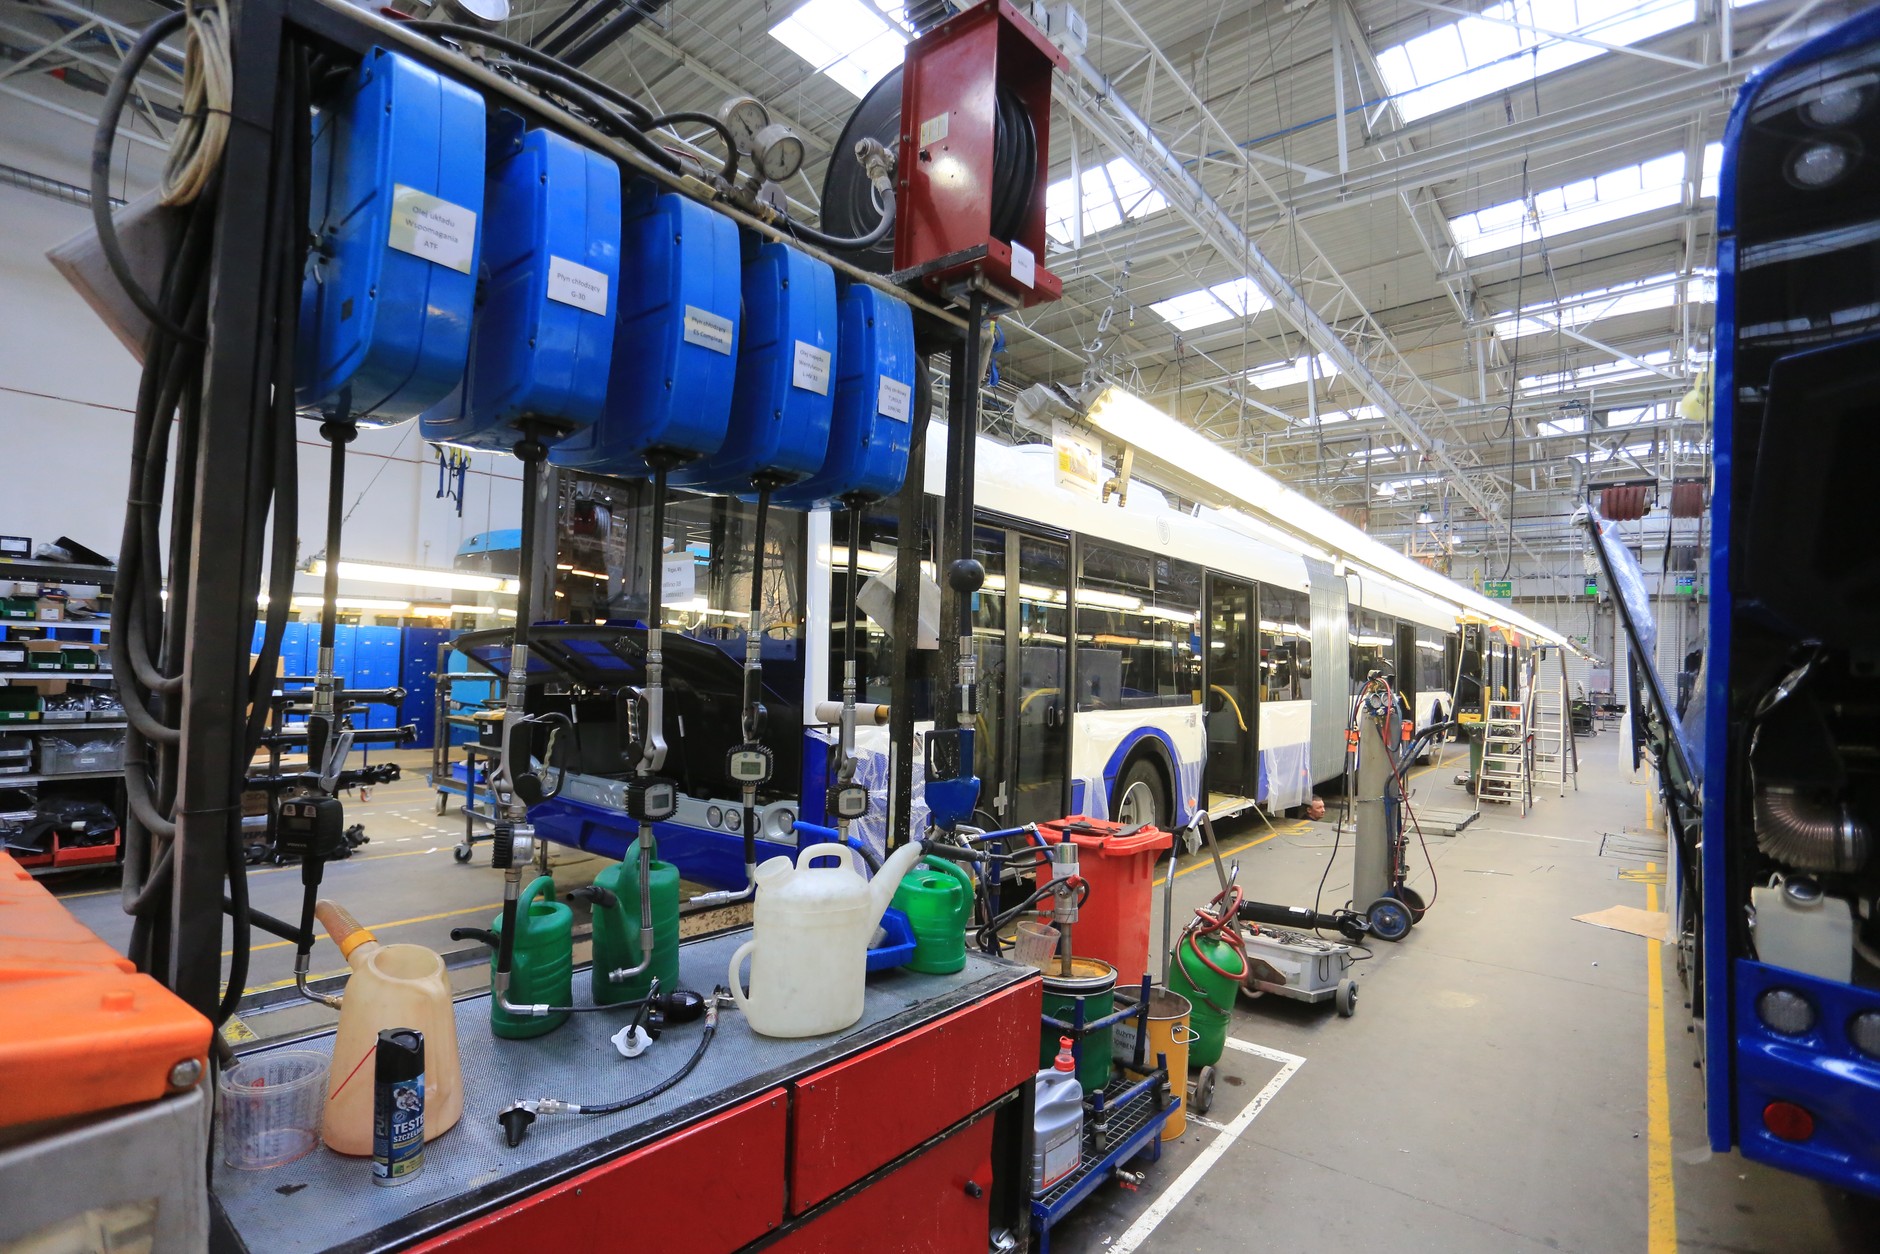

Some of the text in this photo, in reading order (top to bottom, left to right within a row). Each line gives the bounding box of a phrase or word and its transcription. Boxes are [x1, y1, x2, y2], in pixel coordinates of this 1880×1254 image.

[412, 206, 455, 227] Olej układu
[405, 218, 458, 243] Wspomagania
[424, 241, 438, 250] ATF
[393, 1113, 425, 1135] TESTE
